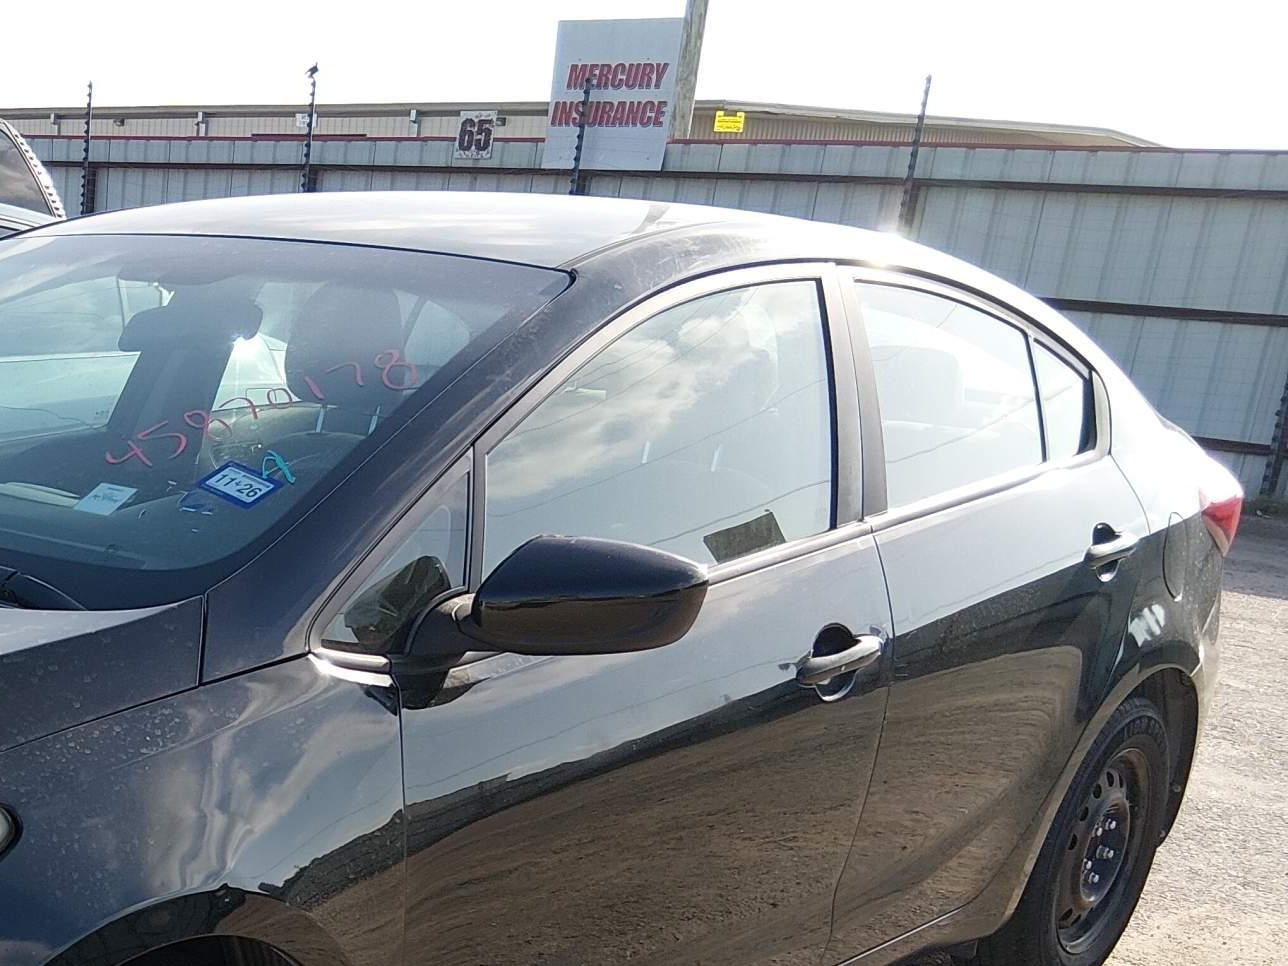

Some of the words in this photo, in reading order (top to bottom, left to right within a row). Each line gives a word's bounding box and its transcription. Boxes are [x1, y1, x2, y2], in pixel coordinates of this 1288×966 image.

[566, 62, 669, 90] MERCURY
[551, 100, 668, 128] INSURANCE
[458, 118, 494, 151] 65
[105, 350, 418, 467] 45870178
